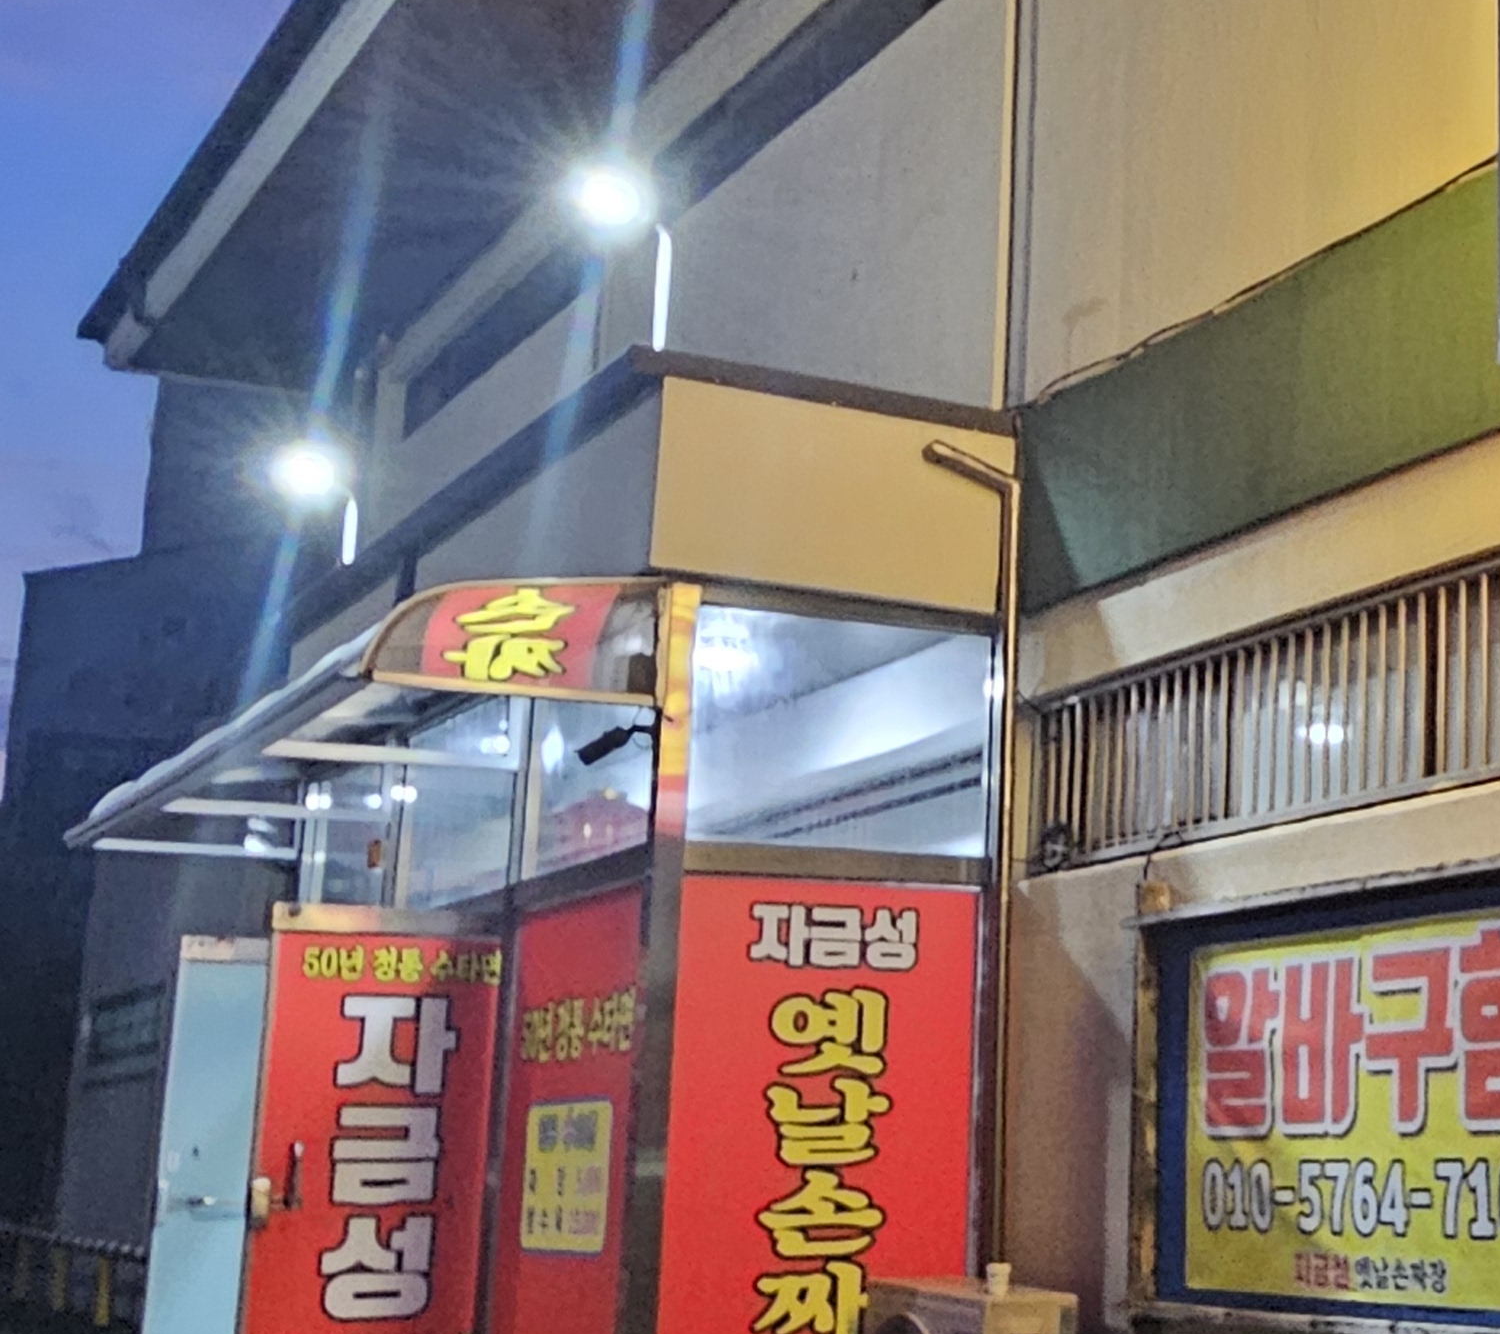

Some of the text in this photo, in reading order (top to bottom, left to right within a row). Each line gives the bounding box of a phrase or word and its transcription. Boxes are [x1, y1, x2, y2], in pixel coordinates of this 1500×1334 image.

[303, 944, 365, 983] 50년
[748, 903, 918, 971] 자금성
[318, 992, 459, 1323] 자금성
